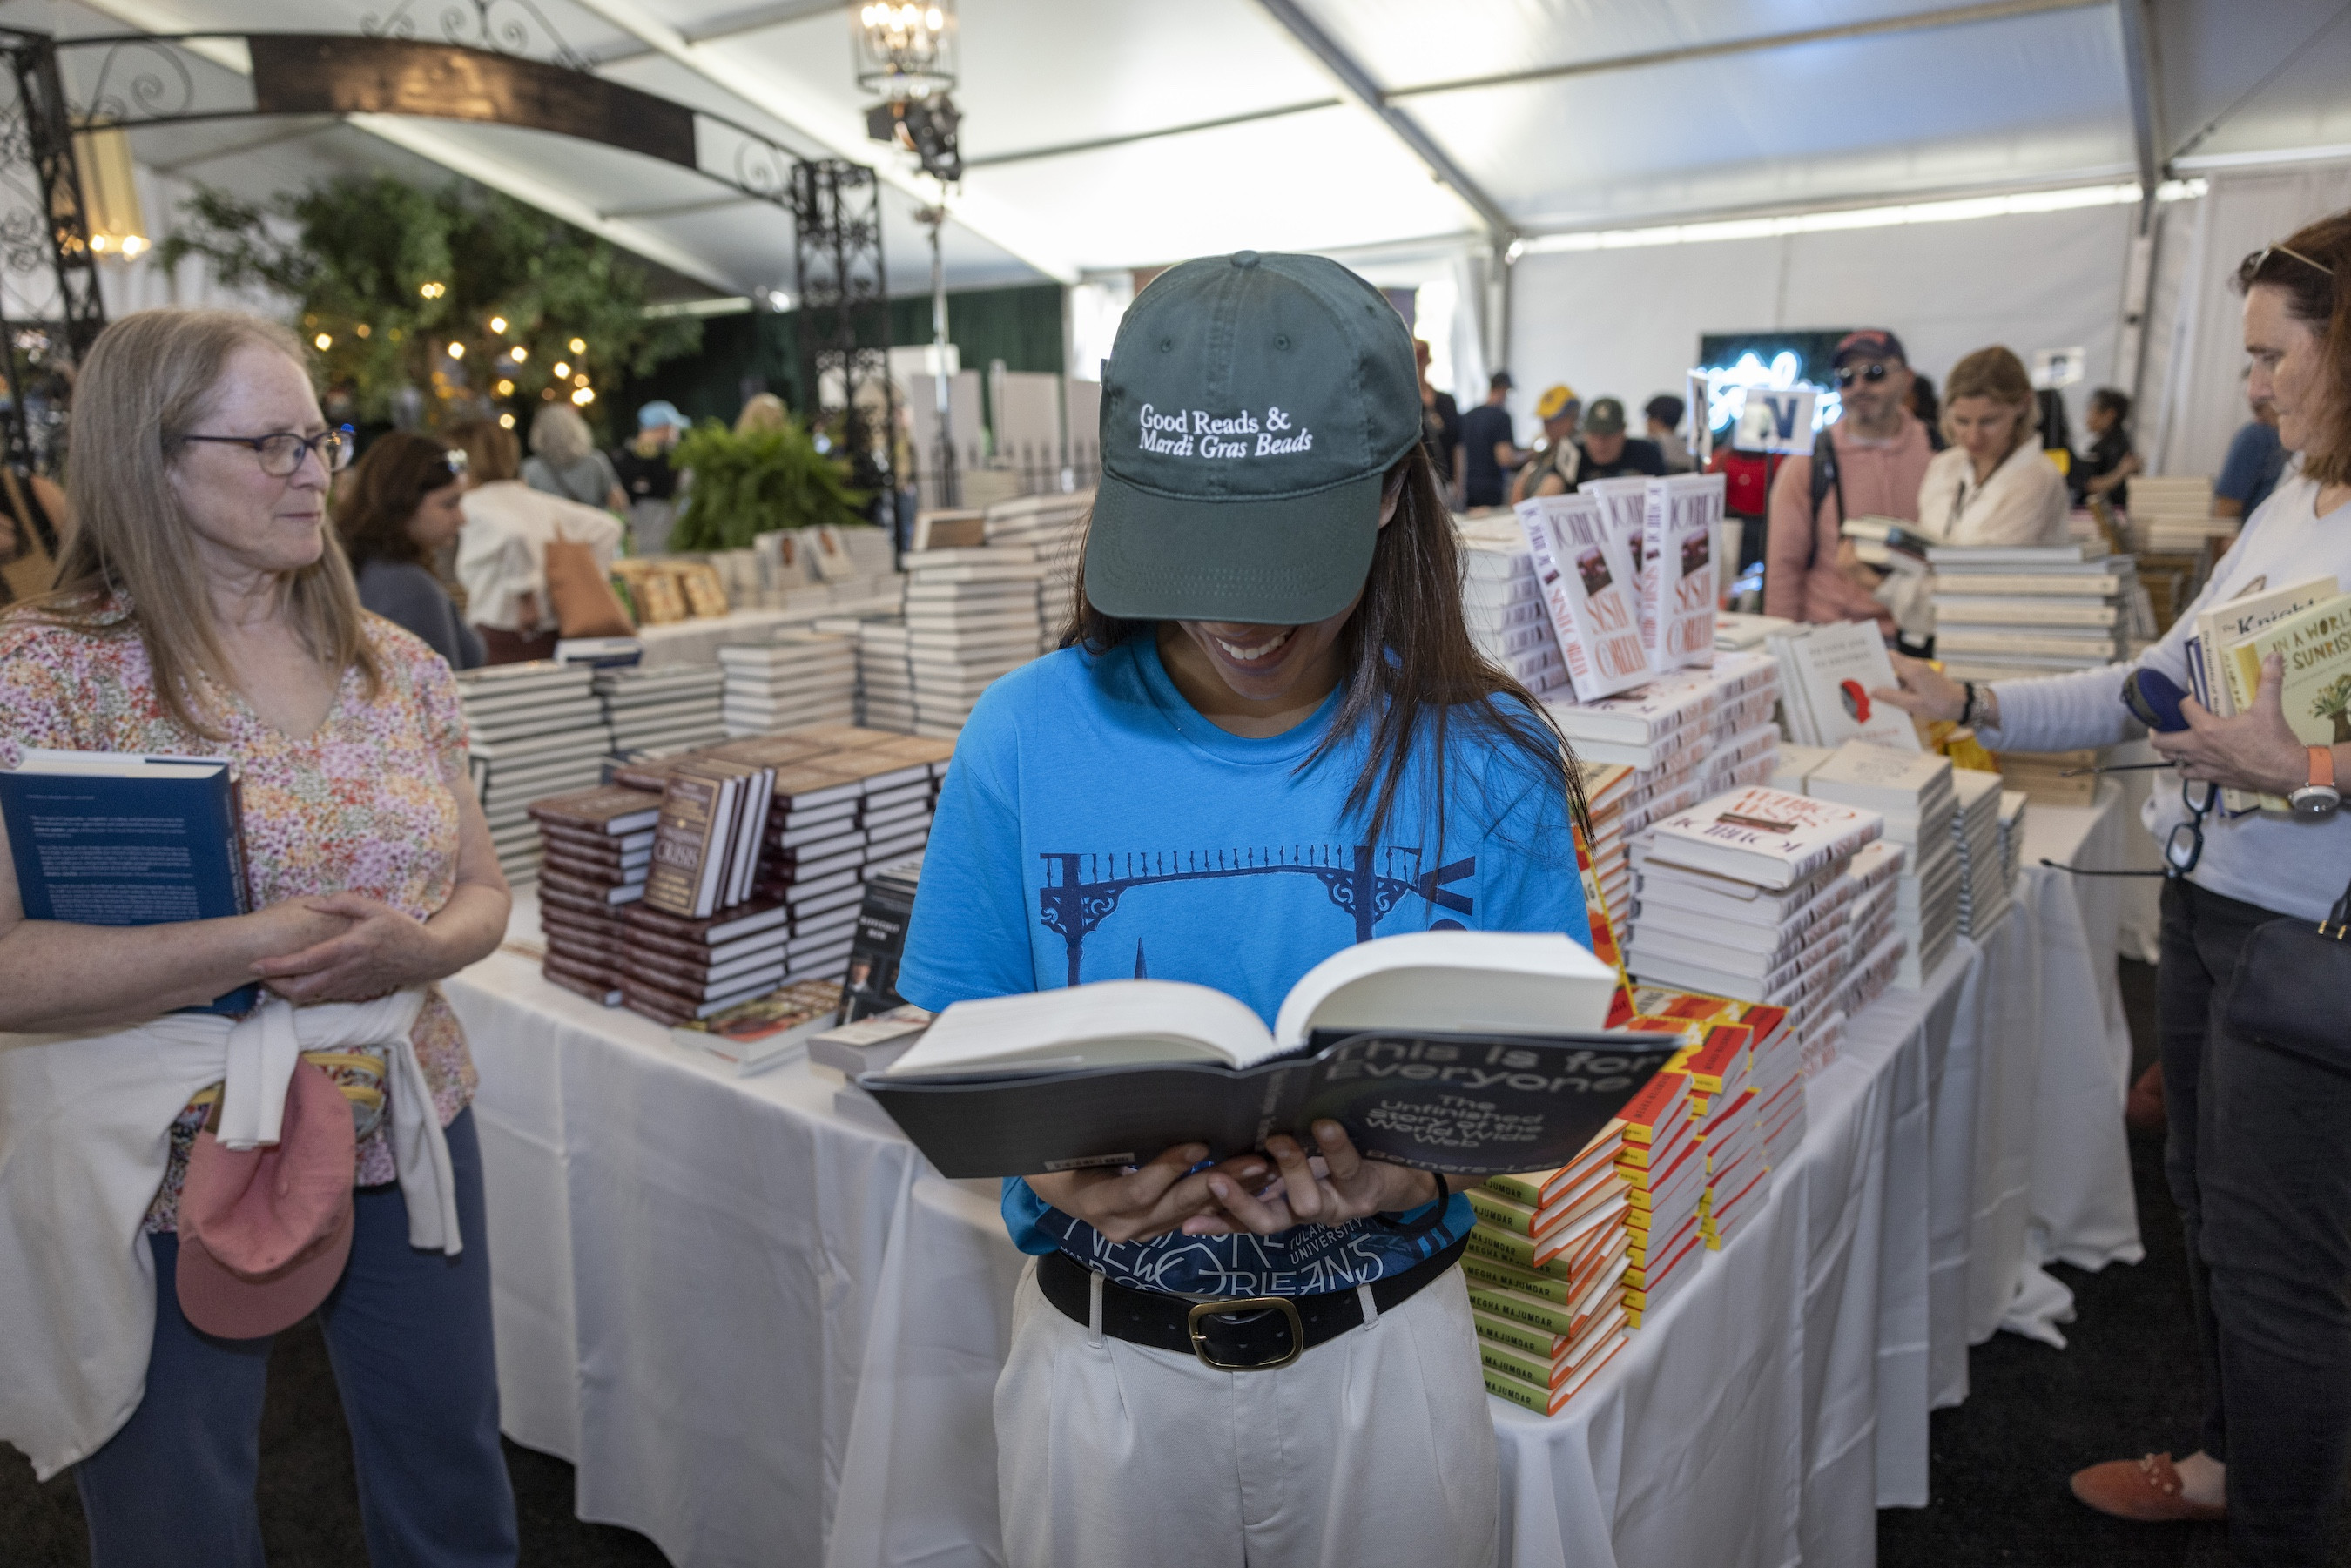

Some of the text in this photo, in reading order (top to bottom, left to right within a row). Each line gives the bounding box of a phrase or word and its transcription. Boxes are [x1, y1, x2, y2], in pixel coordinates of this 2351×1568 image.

[1139, 403, 1291, 434] Good Reads &
[1139, 428, 1313, 459] Mardi Gras Beads
[2294, 631, 2304, 646] A
[1337, 1040, 1461, 1062] This
[1565, 1050, 1664, 1074] for
[1324, 1059, 1634, 1093] Everyone
[1381, 1100, 1544, 1124] Unfinished
[1438, 1094, 1496, 1111] The
[1366, 1117, 1539, 1142] World Wide
[1368, 1107, 1451, 1129] Story
[1456, 1120, 1489, 1130] of
[1414, 1134, 1480, 1148] Web
[1290, 1216, 1364, 1265] UNIVERSITY
[1468, 1243, 1498, 1258] MEGHA
[1471, 1231, 1516, 1255] MAJUMDAR
[1154, 1232, 1384, 1297] ORLEANS
[1467, 1266, 1550, 1296] MEGHA MAJUMDAR
[1470, 1295, 1553, 1328] MEGHA MAJUMDAR
[1486, 1328, 1534, 1351] MAJUMDAR
[1485, 1356, 1533, 1380] MAJUMDAR
[1485, 1380, 1531, 1405] MAJUMDAR
